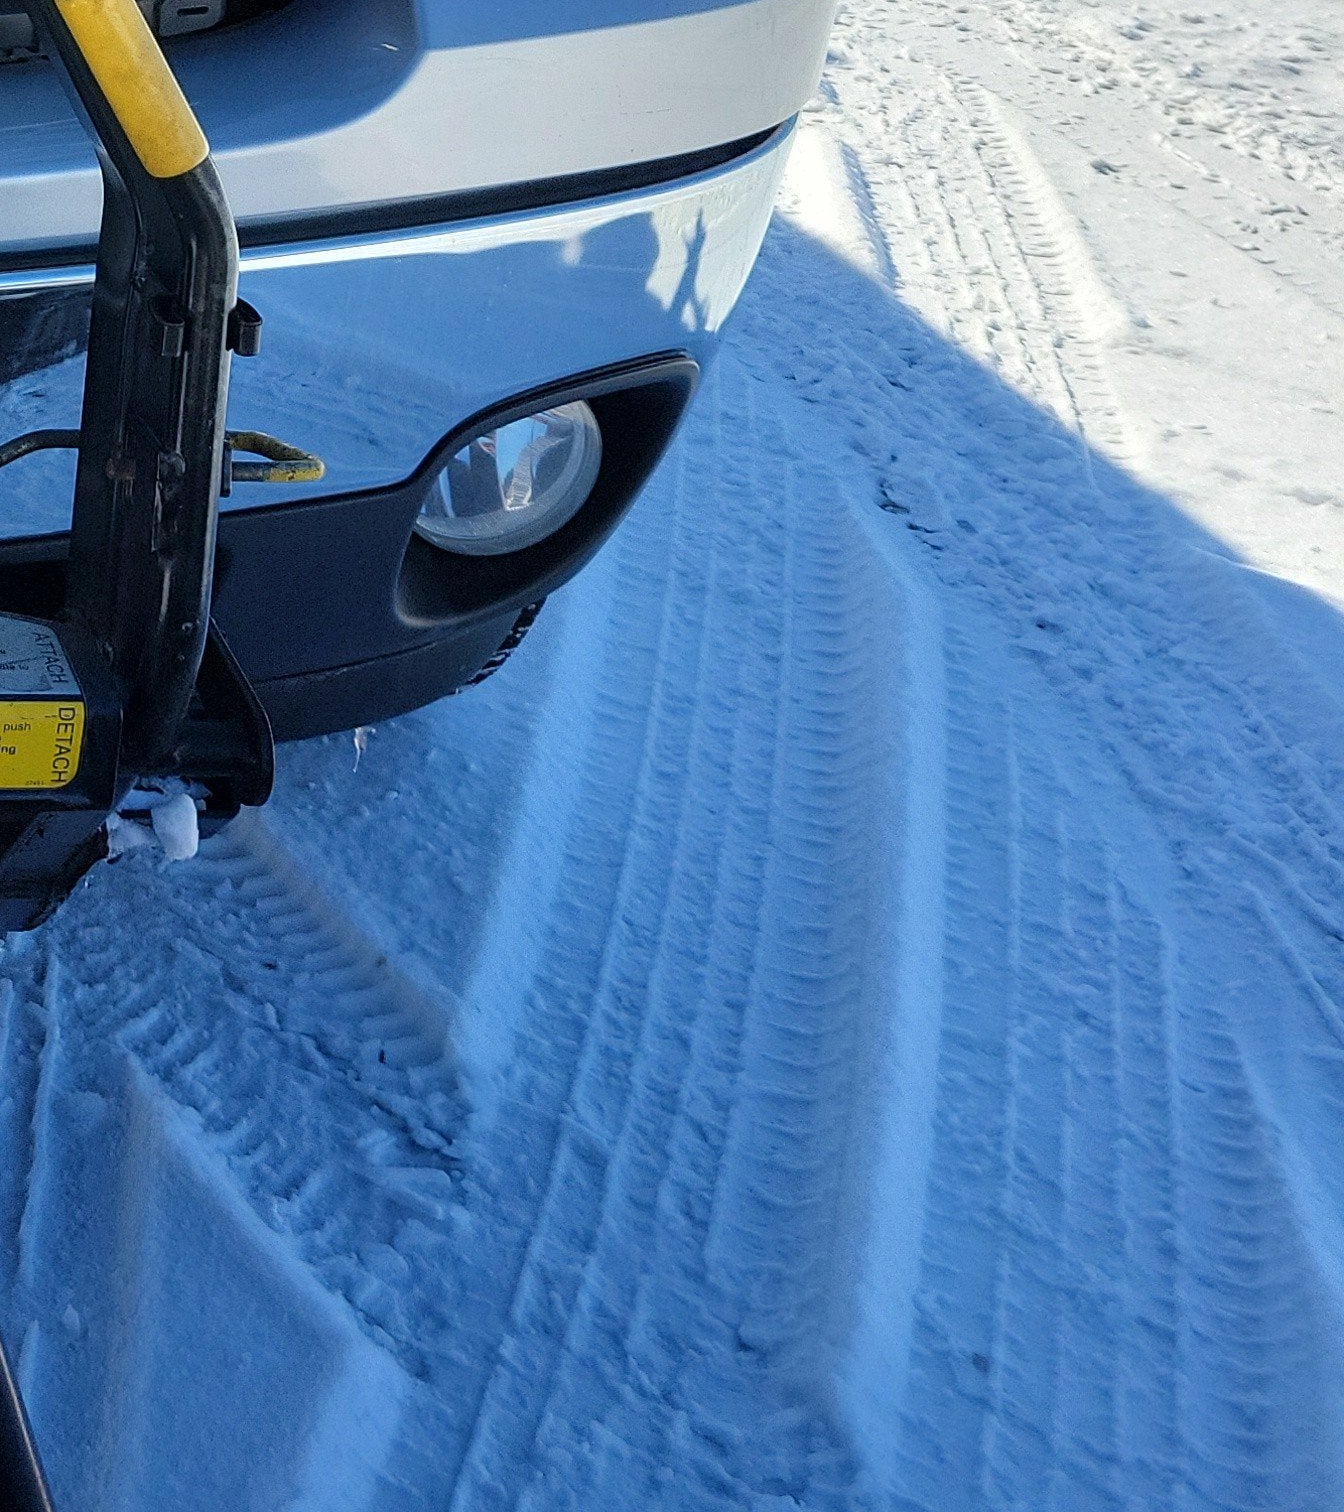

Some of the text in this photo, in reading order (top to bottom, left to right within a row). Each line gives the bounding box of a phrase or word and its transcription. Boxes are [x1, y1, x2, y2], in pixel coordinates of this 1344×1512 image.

[31, 632, 69, 683] ATTACH
[3, 722, 31, 733] push
[50, 707, 76, 783] DETACH
